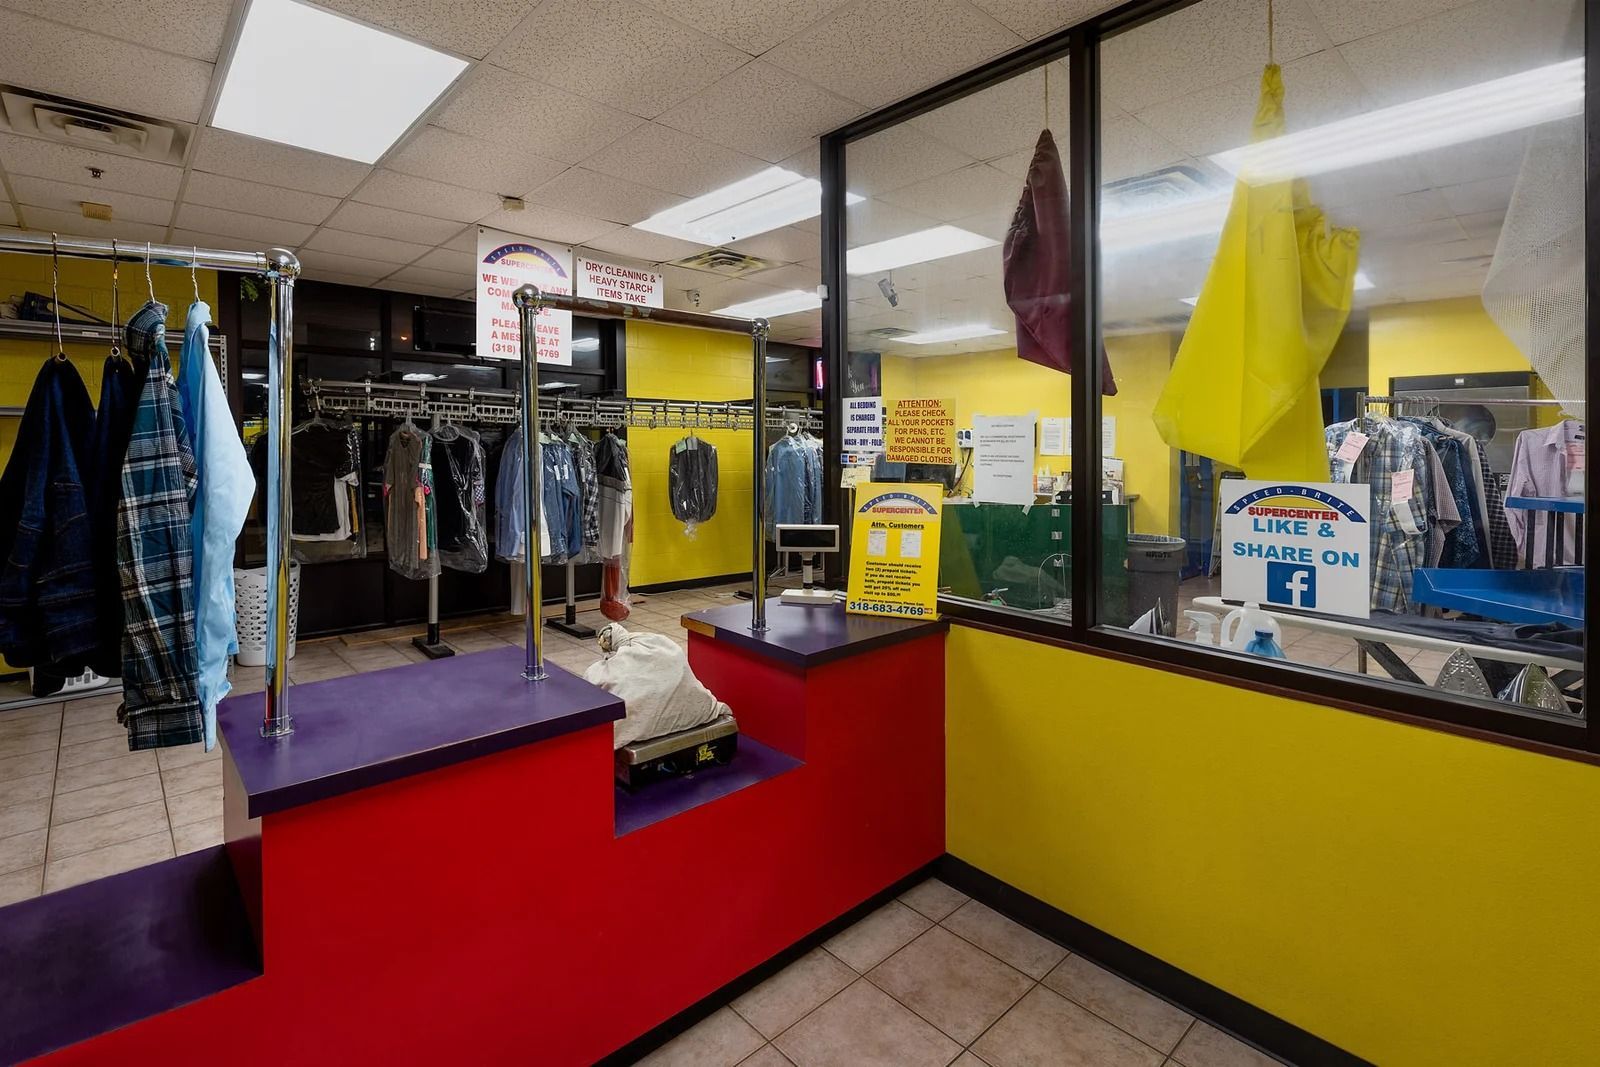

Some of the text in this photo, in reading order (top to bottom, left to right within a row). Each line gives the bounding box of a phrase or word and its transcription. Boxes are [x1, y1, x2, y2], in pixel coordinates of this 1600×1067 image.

[482, 273, 497, 283] WE
[586, 261, 656, 283] DRY CLEANING &
[589, 274, 653, 293] HEAVY STARCH
[596, 287, 646, 303] ITEMS TAKE
[536, 324, 560, 335] EAVE
[491, 330, 498, 339] A
[549, 338, 560, 346] AT
[492, 343, 516, 355] (318)
[898, 400, 941, 408] ATTENTION:
[921, 409, 946, 417] CHECK
[907, 437, 935, 445] CANNOT
[889, 446, 935, 454] RESPONSIBLE
[872, 507, 924, 515] SUPERCENTER
[1248, 506, 1339, 521] SUPERCENTER
[1253, 518, 1336, 538] LIKE &
[1233, 541, 1359, 568] SHARE ON
[849, 601, 924, 615] 318-683-4769
